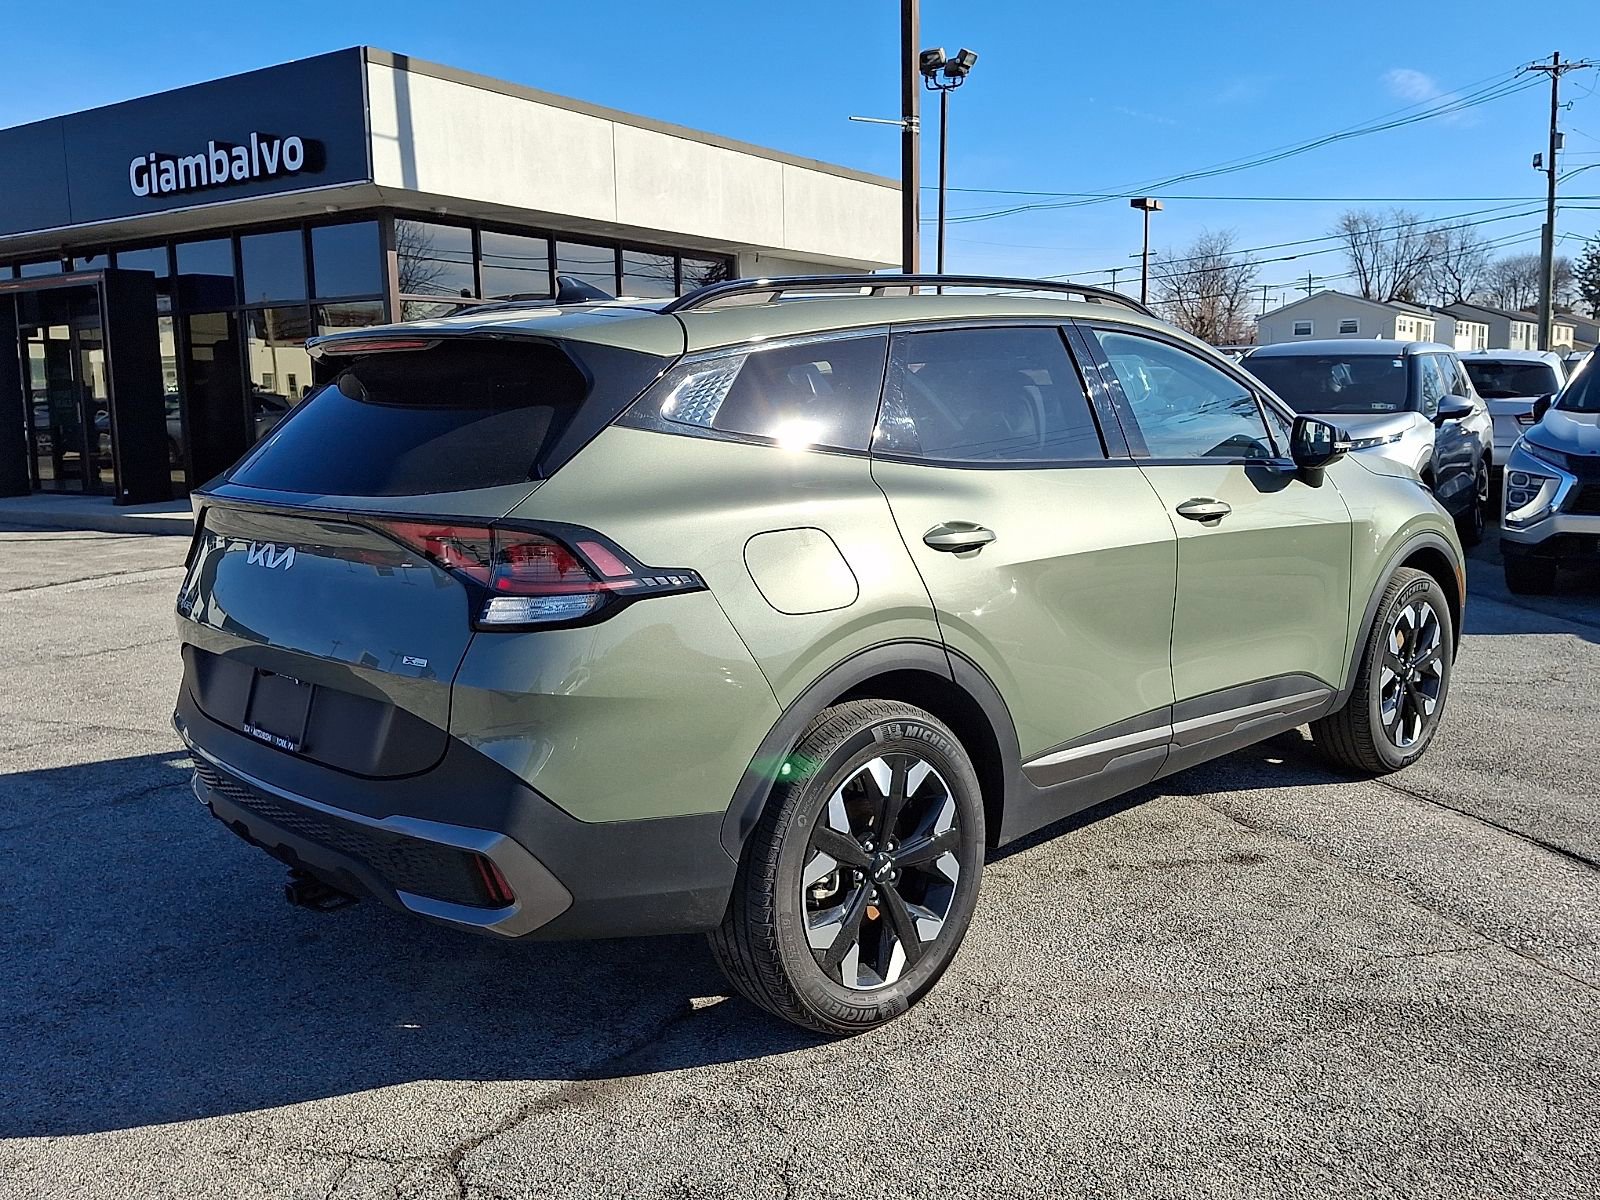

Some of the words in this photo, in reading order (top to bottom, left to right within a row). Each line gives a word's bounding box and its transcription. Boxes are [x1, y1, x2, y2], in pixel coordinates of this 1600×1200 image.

[130, 131, 304, 197] Giambalvo
[904, 725, 962, 771] MICHELIN
[810, 987, 879, 1021] MICHELIN
